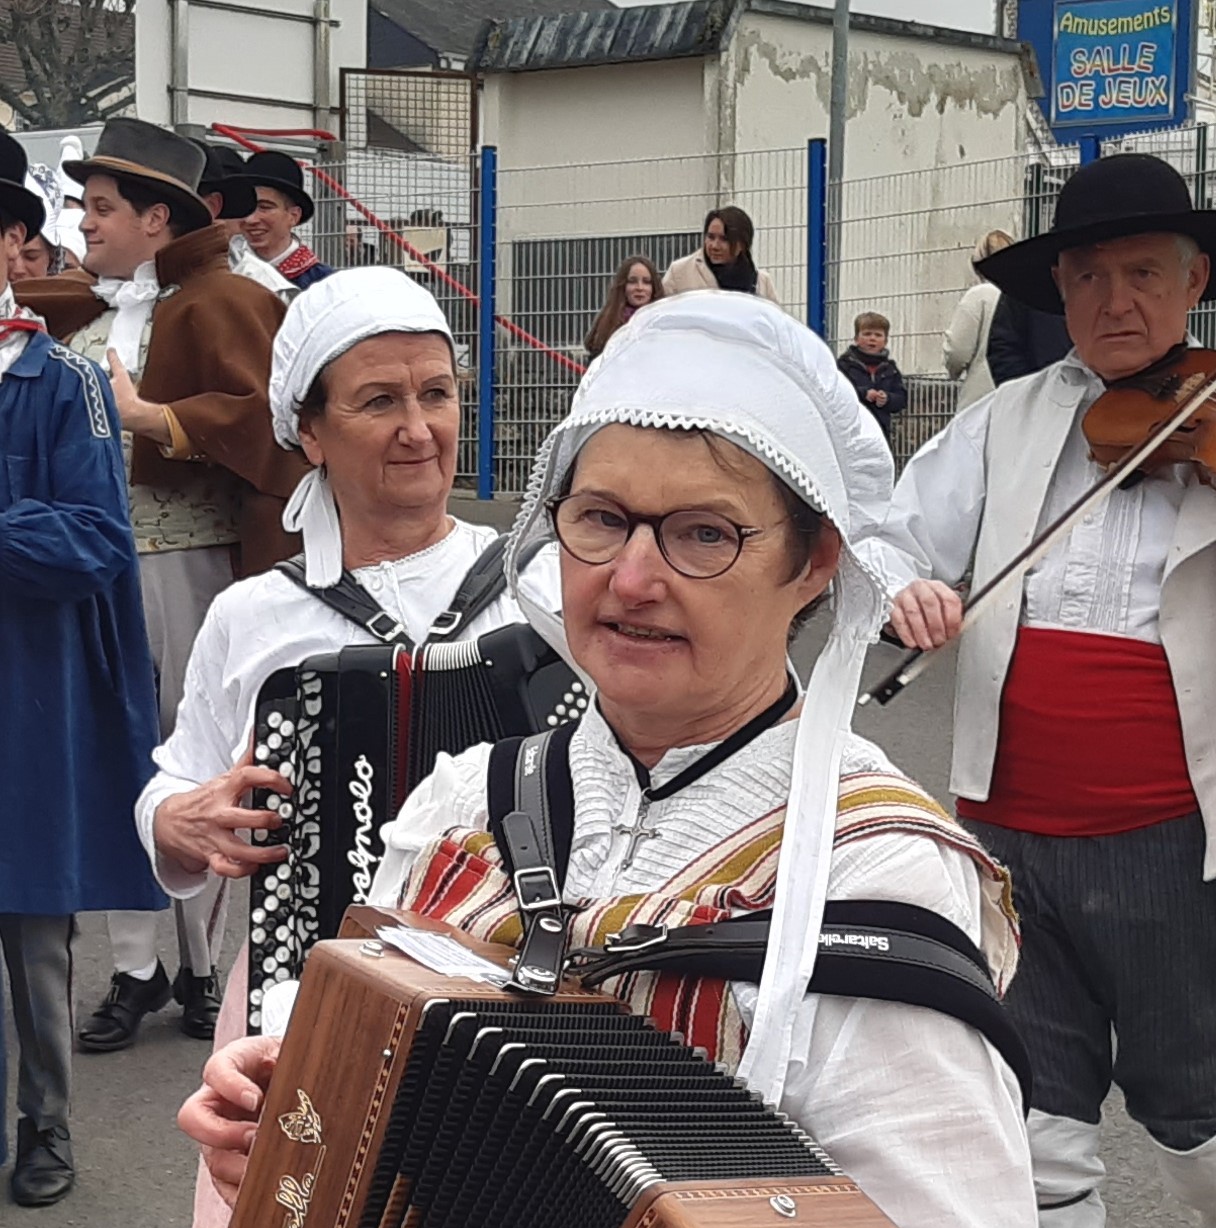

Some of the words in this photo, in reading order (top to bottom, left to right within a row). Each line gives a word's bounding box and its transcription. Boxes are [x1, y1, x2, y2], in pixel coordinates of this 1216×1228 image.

[1059, 6, 1172, 36] Amusements
[1070, 42, 1157, 78] SALLE
[1057, 80, 1094, 112] DE
[1099, 76, 1169, 109] JEUX
